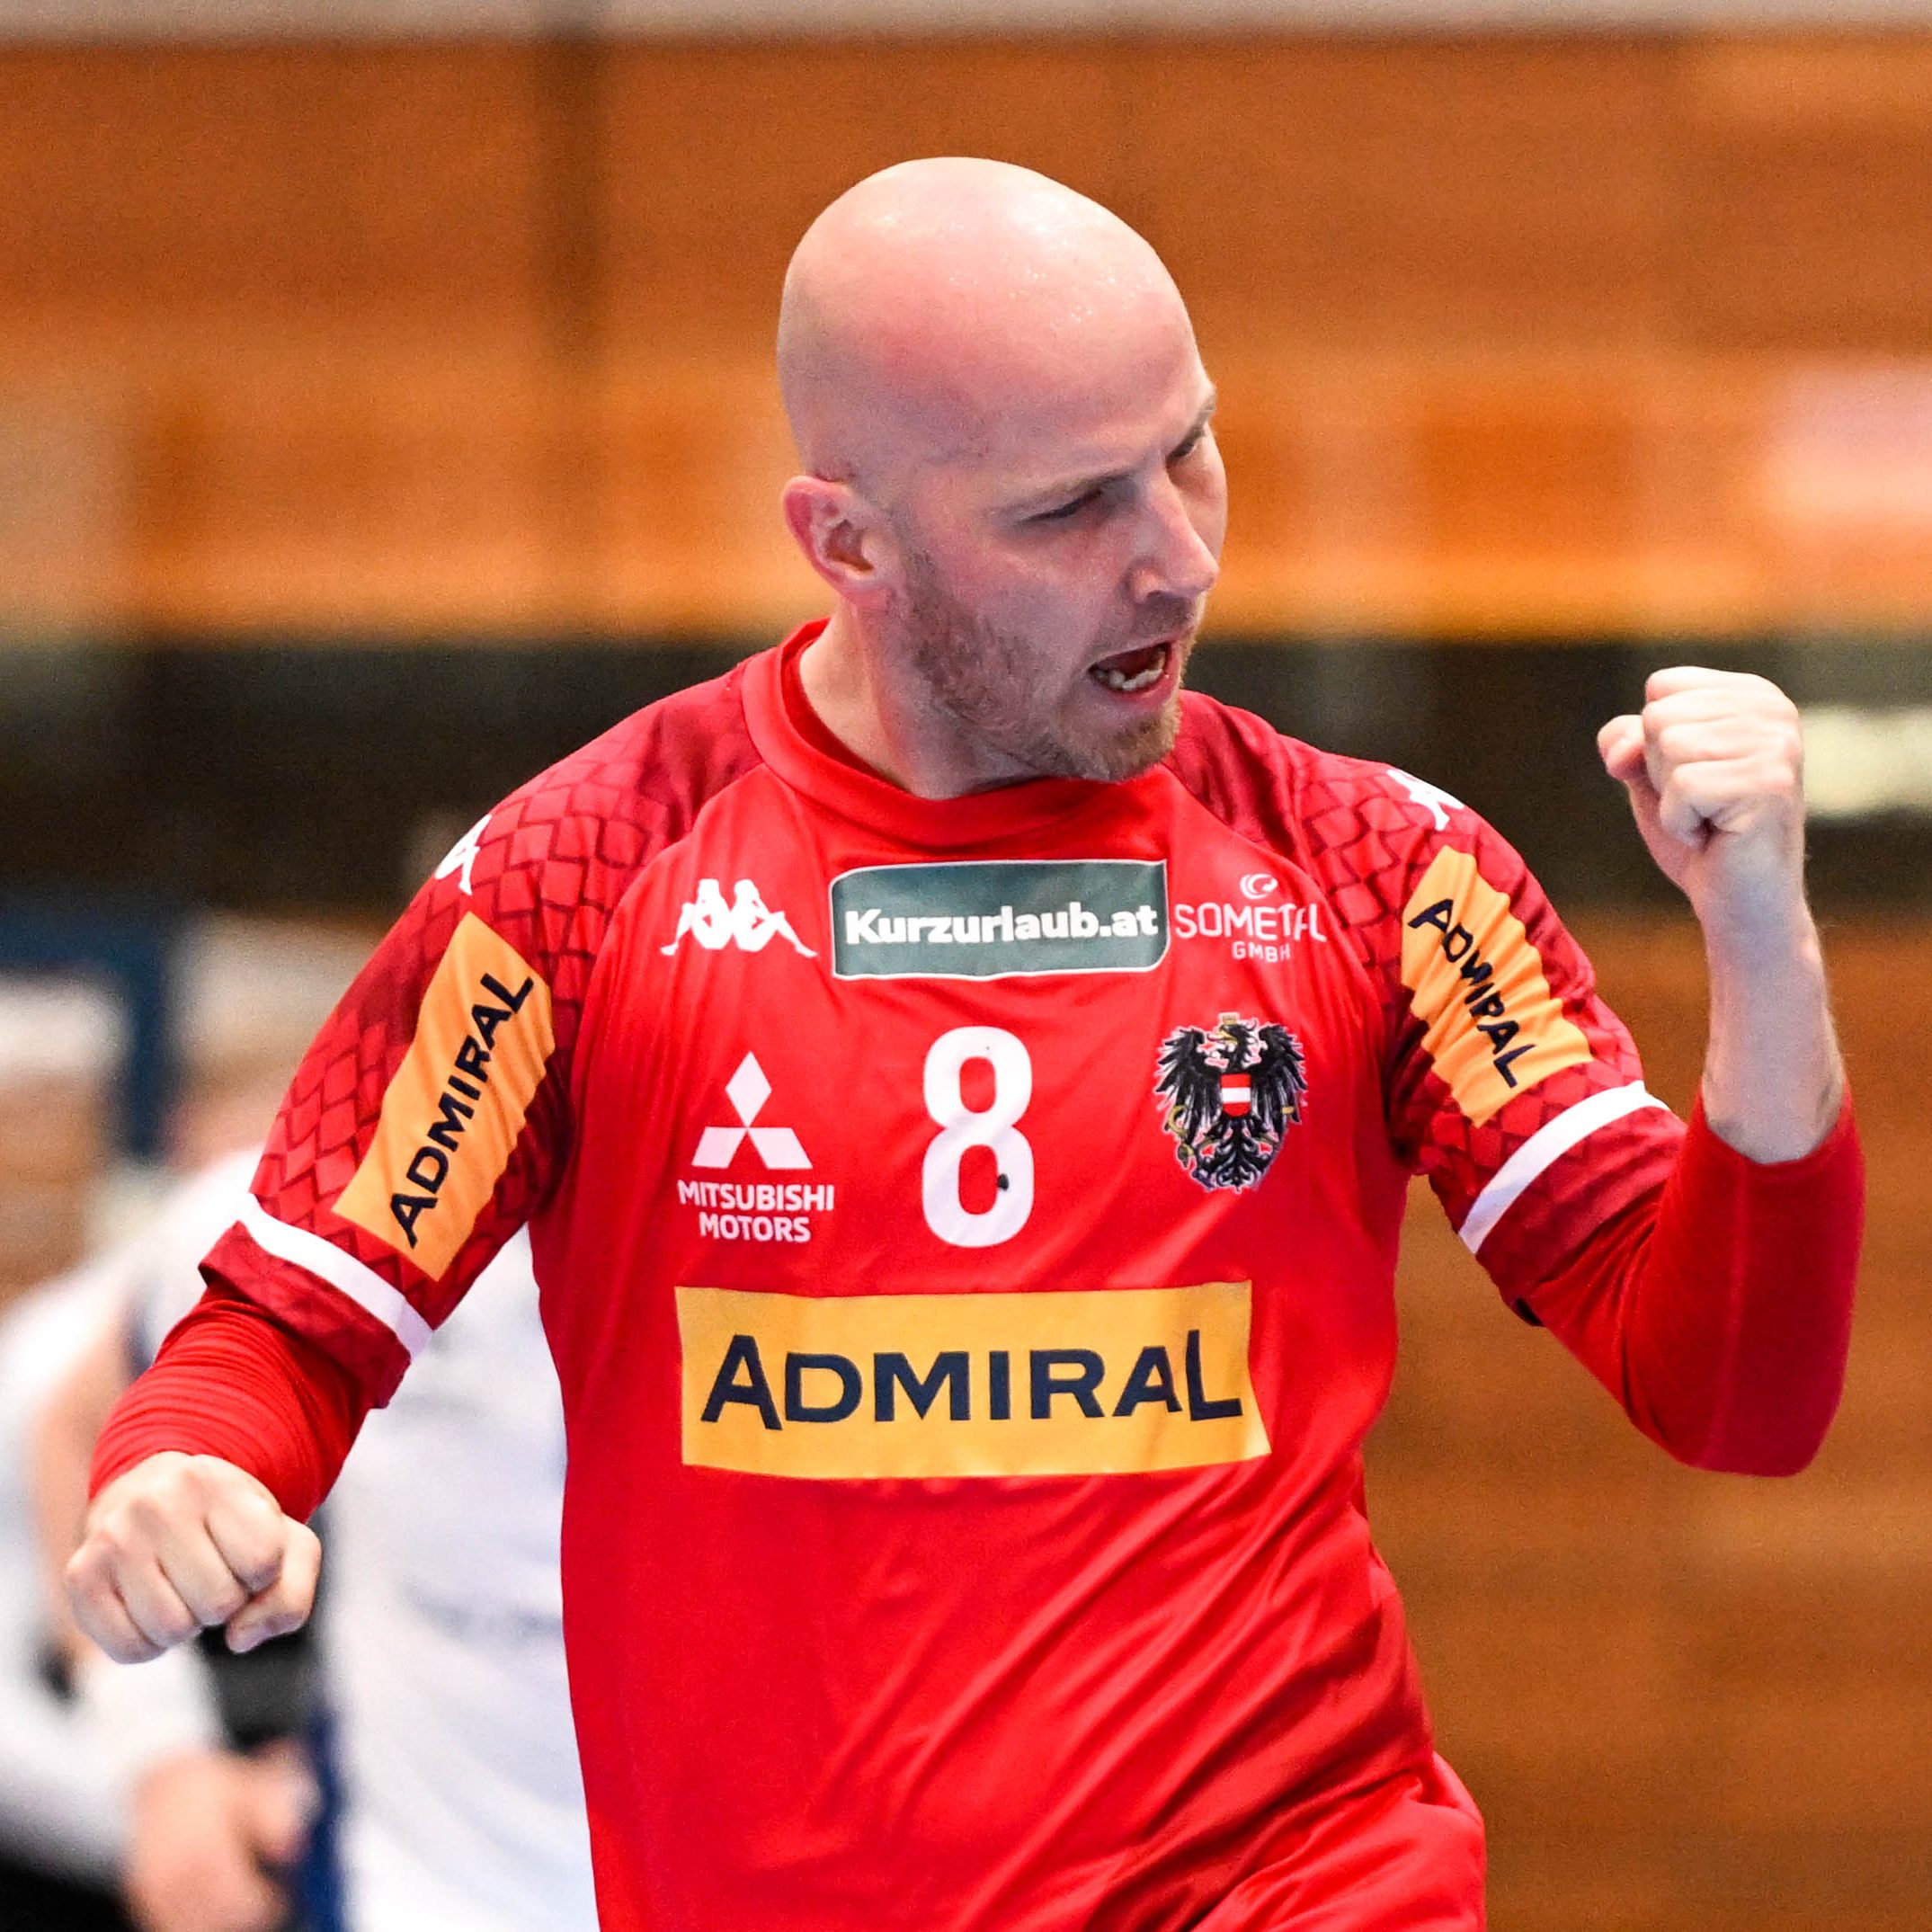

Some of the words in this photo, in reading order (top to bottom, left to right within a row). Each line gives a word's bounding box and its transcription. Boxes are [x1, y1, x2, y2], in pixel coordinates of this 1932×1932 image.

[845, 902, 1160, 946] Kurzurlaub.at
[1174, 902, 1327, 942] SOMETAL
[1233, 941, 1291, 963] GMBH
[1407, 897, 1537, 1088] ADMIRAL
[390, 972, 534, 1249] ADMIRAL
[922, 1026, 1034, 1248] 8
[677, 1180, 835, 1212] MITSUBISHI
[699, 1211, 811, 1243] MOTORS
[699, 1329, 1242, 1431] ADMIRAL
